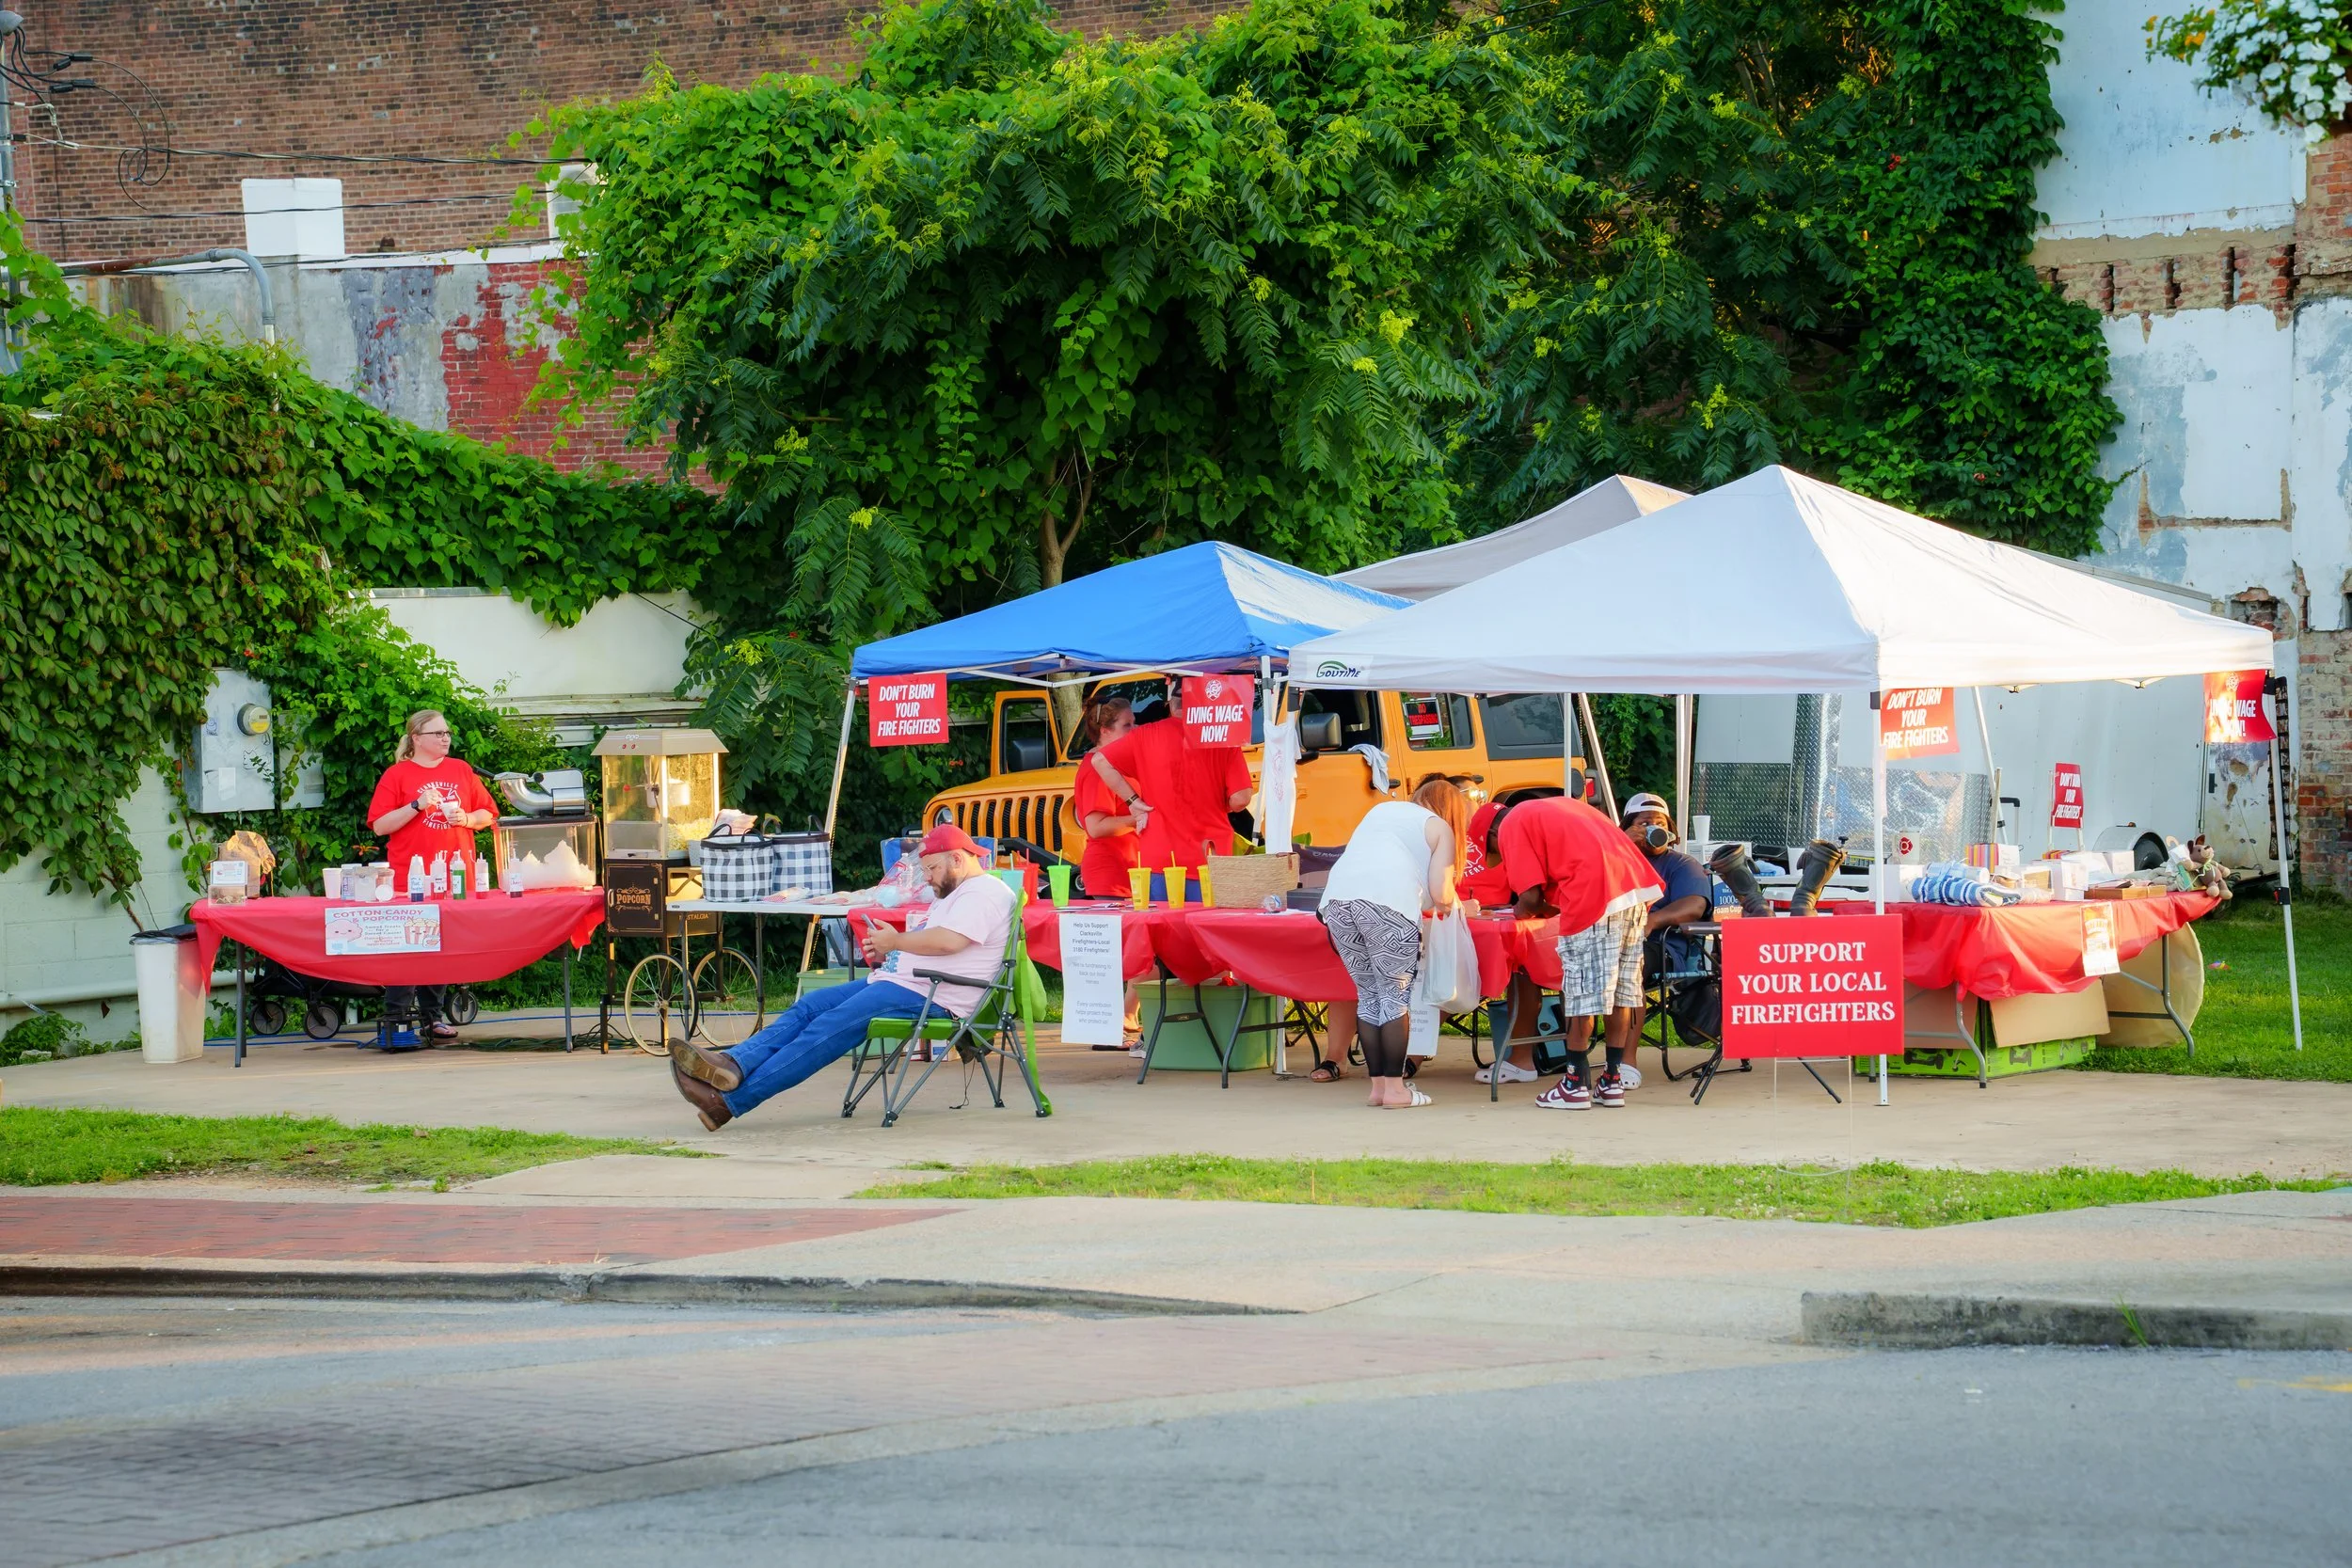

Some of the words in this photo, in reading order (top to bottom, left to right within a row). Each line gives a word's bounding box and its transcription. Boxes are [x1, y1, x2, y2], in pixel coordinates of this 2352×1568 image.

[879, 685, 908, 702] DON'T
[908, 684, 935, 700] BURN
[1886, 689, 1916, 710] DON'T
[1915, 688, 1943, 707] BURN
[896, 702, 920, 718] YOUR
[1186, 706, 1214, 724] LIVING
[1215, 705, 1244, 722] WAGE
[1901, 708, 1927, 728] YOUR
[877, 721, 898, 736] FIRE
[898, 718, 942, 736] FIGHTERS
[1200, 724, 1229, 743] NOW!
[1883, 730, 1903, 750] FIRE
[1903, 725, 1949, 748] FIGHTERS
[616, 894, 651, 905] POPCORN
[333, 910, 382, 918] COTTON
[1713, 906, 1729, 914] Foam
[1758, 942, 1867, 963] SUPPORT
[1738, 974, 1804, 994] YOUR
[1809, 972, 1887, 992] LOCAL
[1730, 1001, 1896, 1024] FIREFIGHTERS
